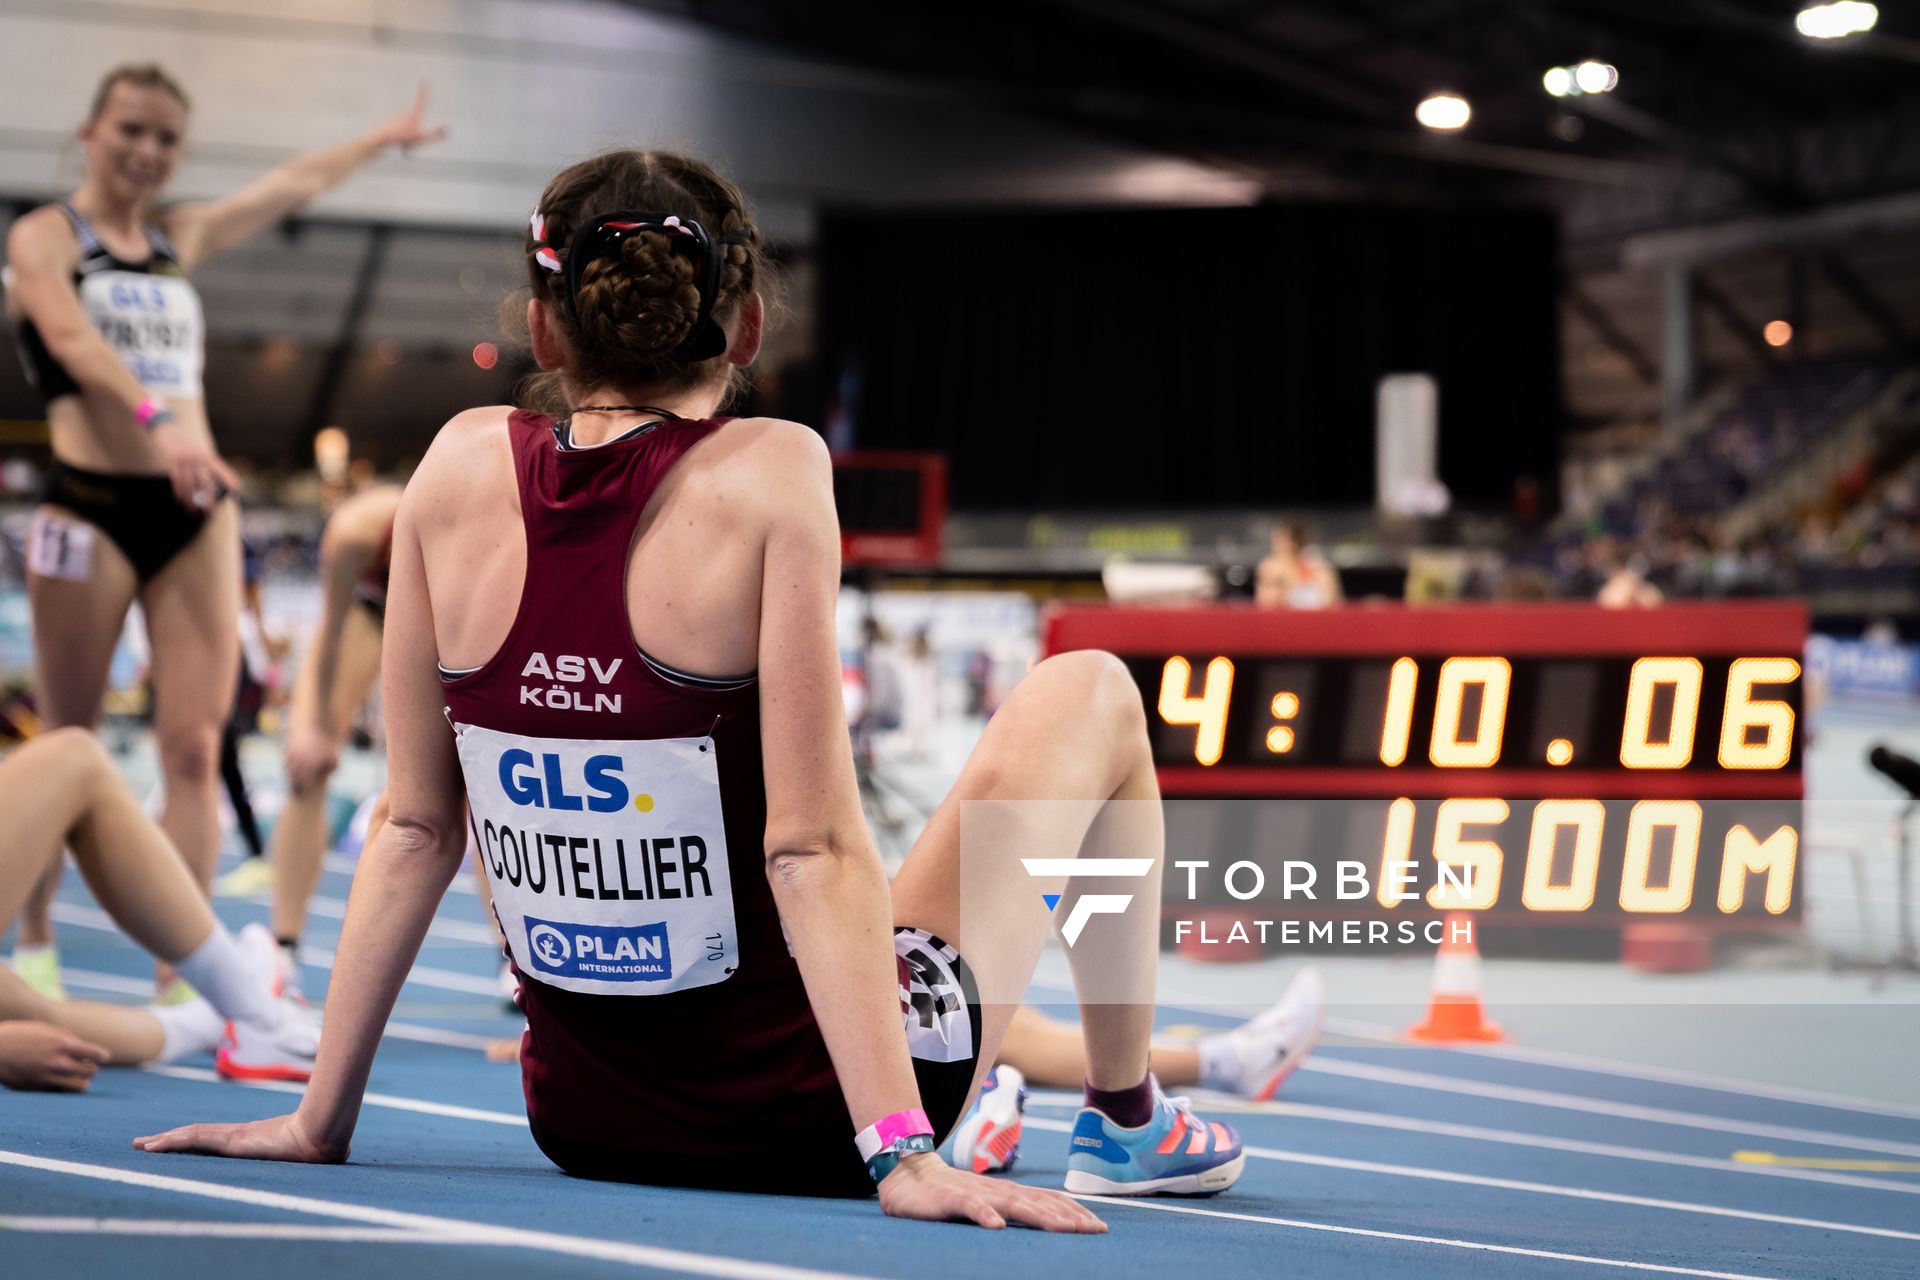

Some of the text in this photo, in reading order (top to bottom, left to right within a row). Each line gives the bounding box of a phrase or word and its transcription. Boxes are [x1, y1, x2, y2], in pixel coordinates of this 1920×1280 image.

[521, 652, 623, 684] ASV
[519, 684, 622, 713] KÖLN
[484, 818, 713, 901] COUTELLIER
[575, 934, 662, 961] PLAN
[705, 932, 724, 961] 170
[578, 962, 664, 974] INTERNATIONAL
